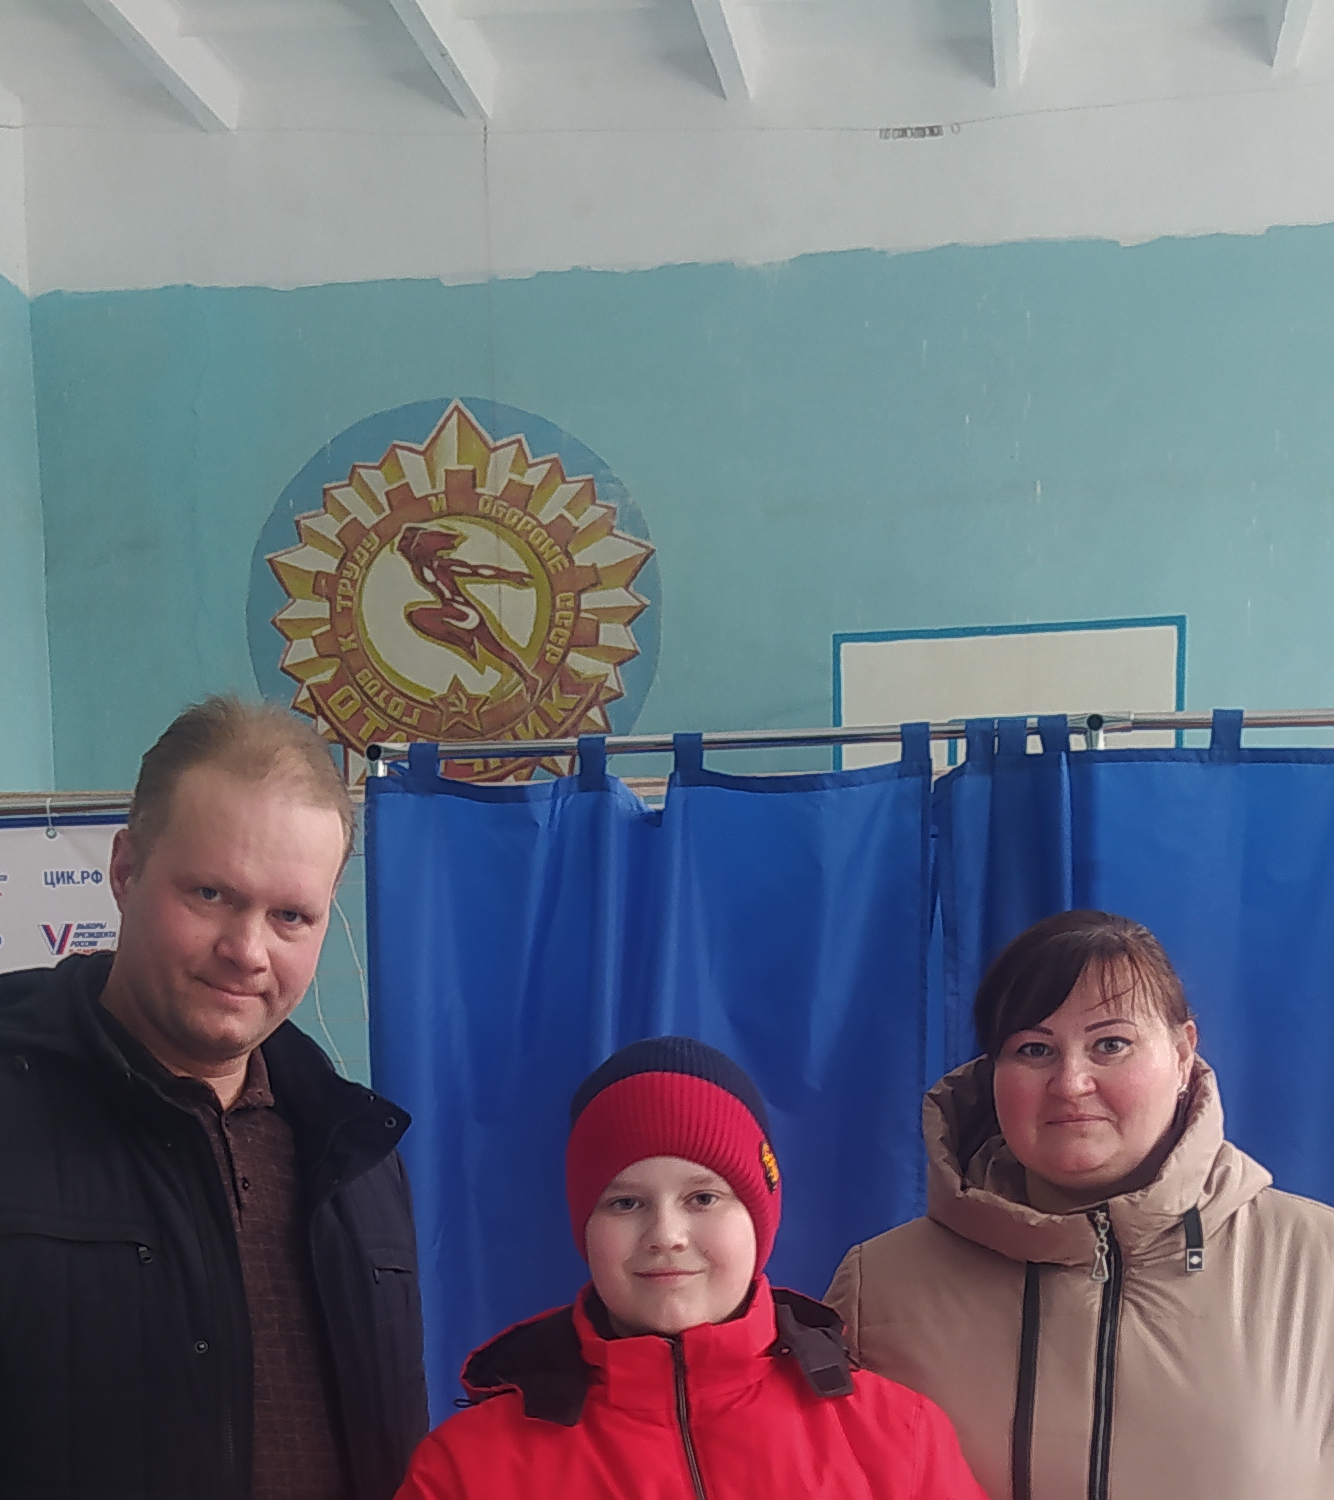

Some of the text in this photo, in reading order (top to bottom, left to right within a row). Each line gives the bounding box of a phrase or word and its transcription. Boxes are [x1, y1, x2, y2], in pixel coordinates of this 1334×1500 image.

[428, 494, 447, 514] И
[478, 495, 570, 574] ОБОРОНЕ
[336, 531, 380, 613] ТРУДУ
[338, 633, 358, 652] К
[355, 668, 421, 726] ГОТОВ
[43, 869, 104, 890] ЦИК.РФ
